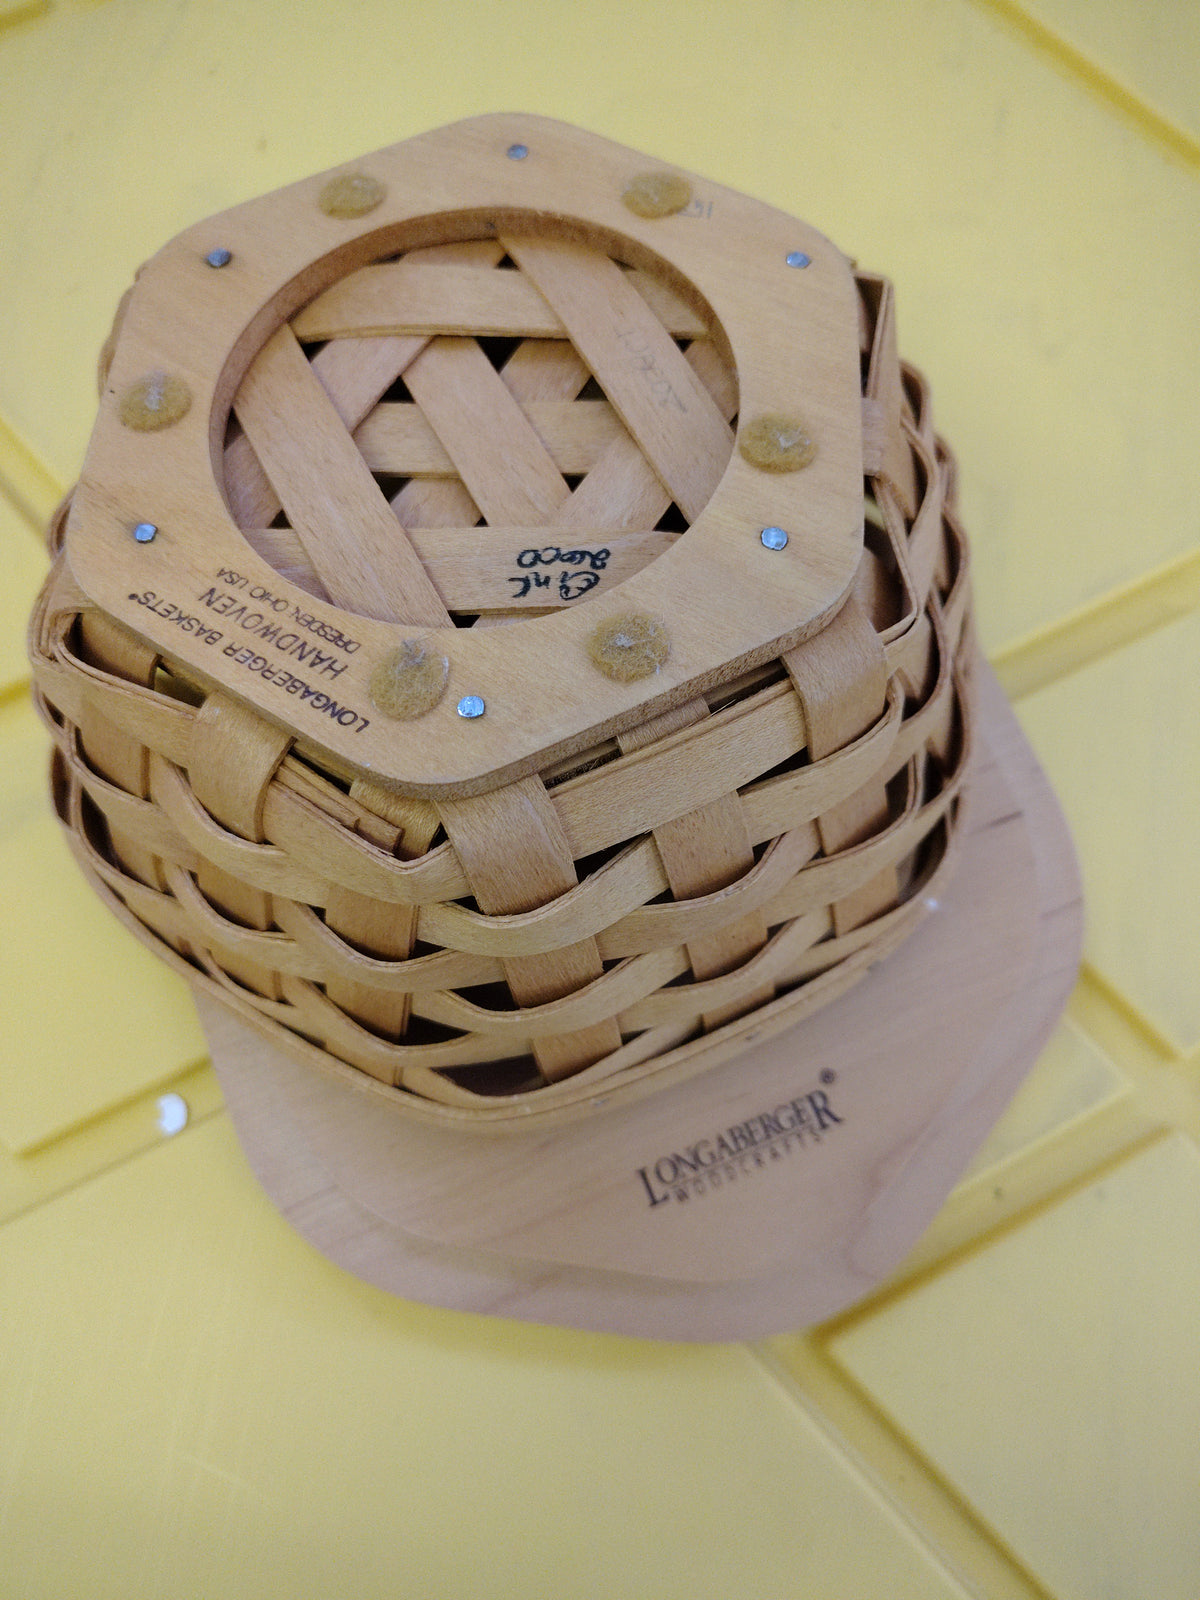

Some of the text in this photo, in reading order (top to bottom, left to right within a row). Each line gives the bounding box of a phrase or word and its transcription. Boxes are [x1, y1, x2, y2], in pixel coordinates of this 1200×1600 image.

[217, 567, 249, 587] USA
[249, 586, 289, 612] OHIO
[198, 587, 348, 680] HANDWOVEN
[222, 642, 370, 733] LONGABERGER
